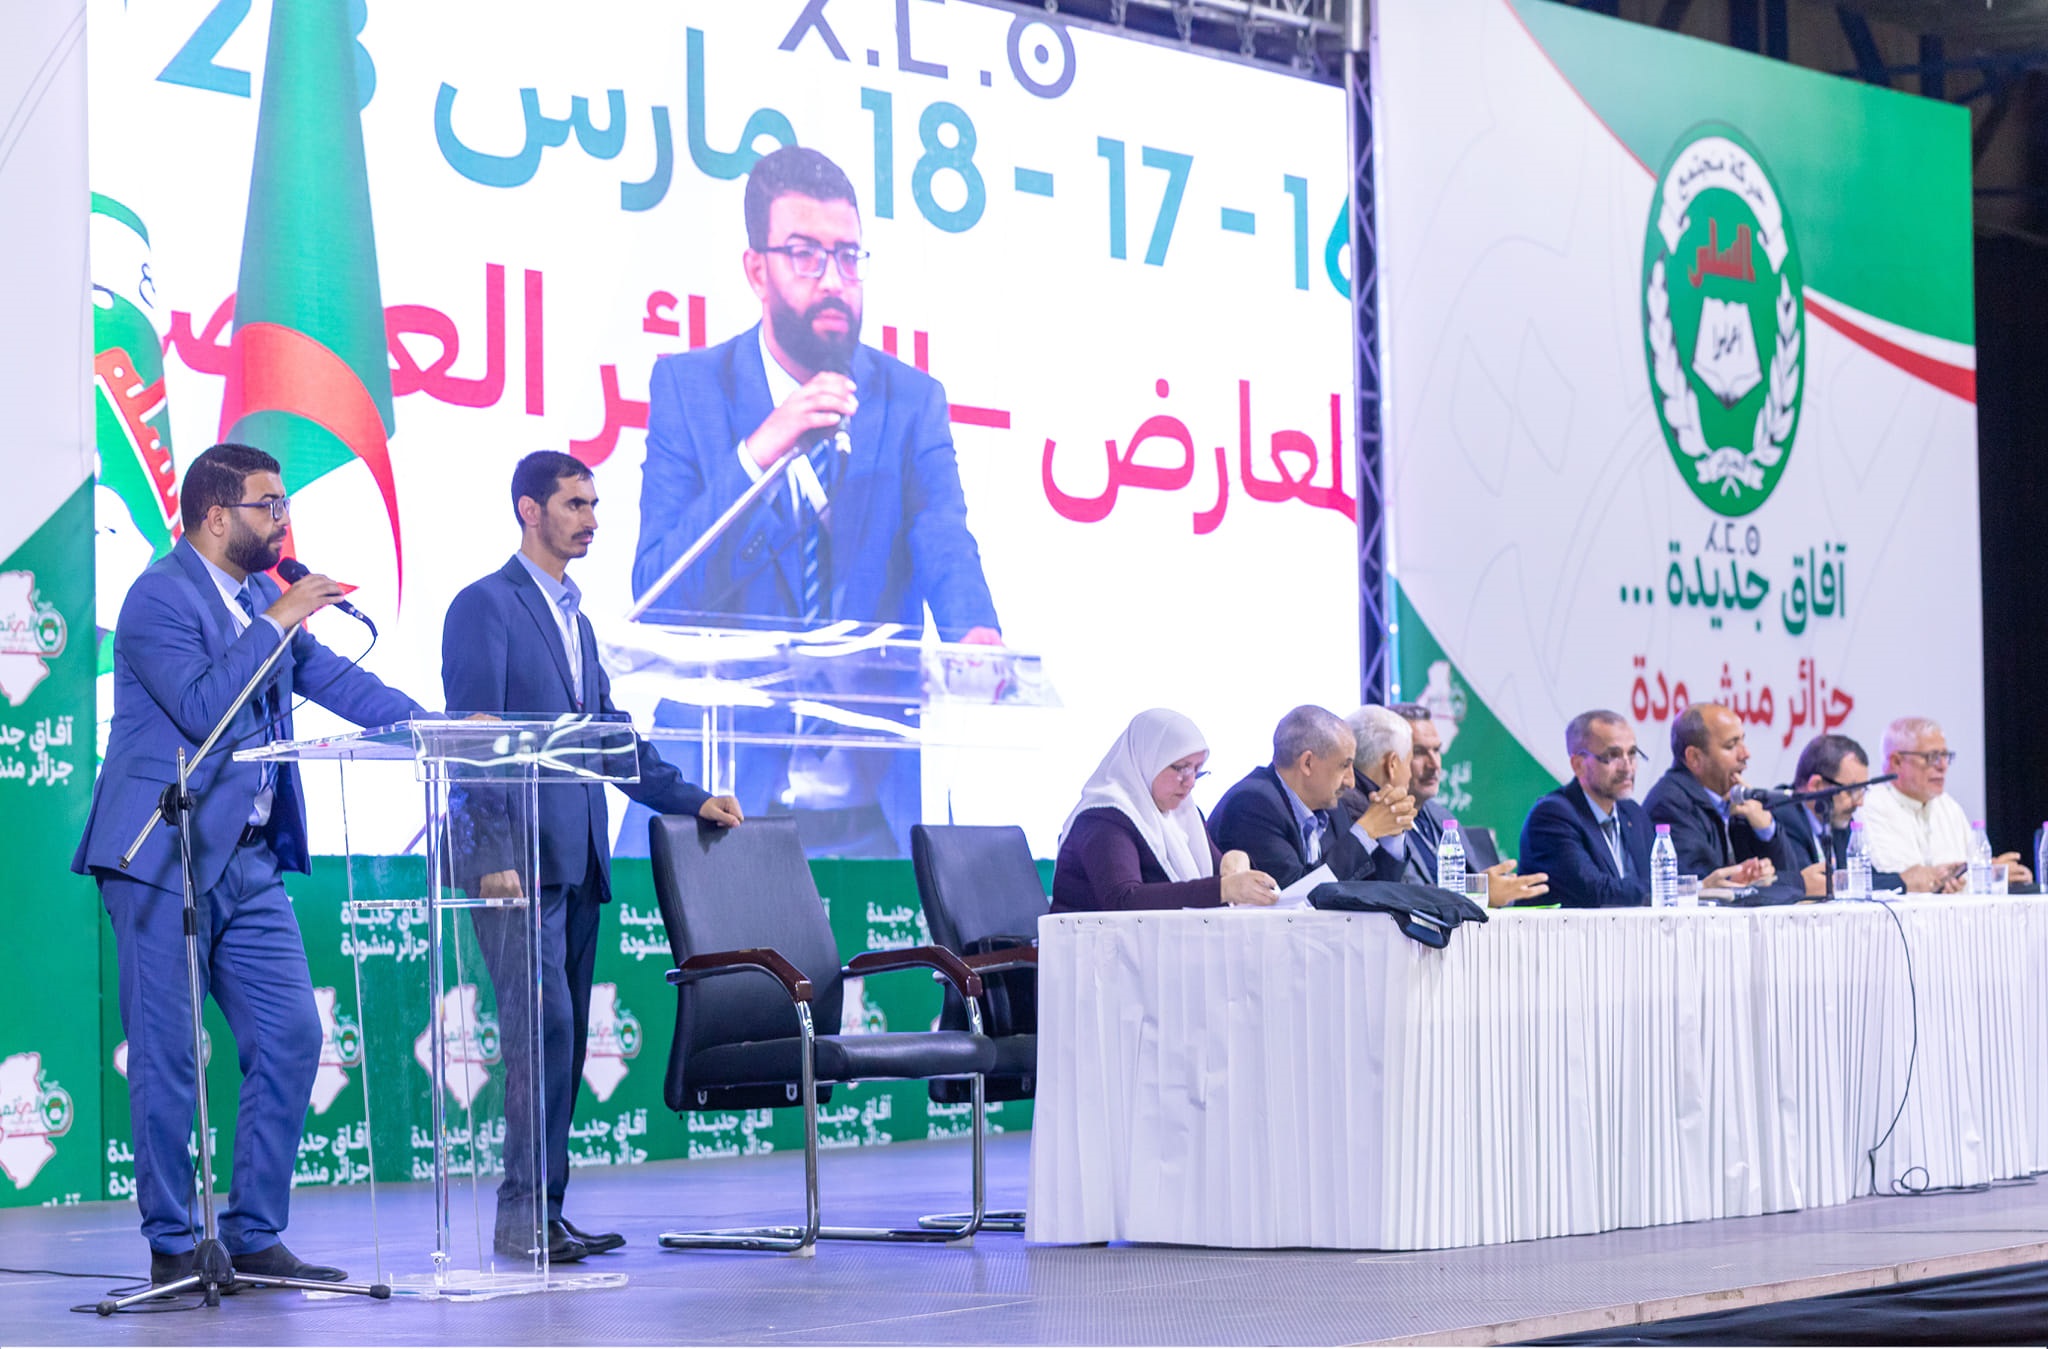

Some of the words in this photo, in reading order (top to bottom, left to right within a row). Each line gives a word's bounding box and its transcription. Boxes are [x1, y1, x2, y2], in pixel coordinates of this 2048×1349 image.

[860, 86, 986, 234] 18
[1097, 136, 1194, 267] 17
[1667, 540, 1769, 632] جديدة
[1781, 541, 1847, 636] آفاق
[29, 715, 73, 752] آفاق
[27, 752, 74, 786] جزائر
[619, 903, 665, 932] ديدة
[866, 902, 915, 928] جديدة
[612, 1108, 648, 1142] آفاق
[816, 1104, 860, 1128] جديد
[860, 1094, 892, 1127] آفاق
[568, 1118, 611, 1143] جديد
[568, 1145, 612, 1168] منشود
